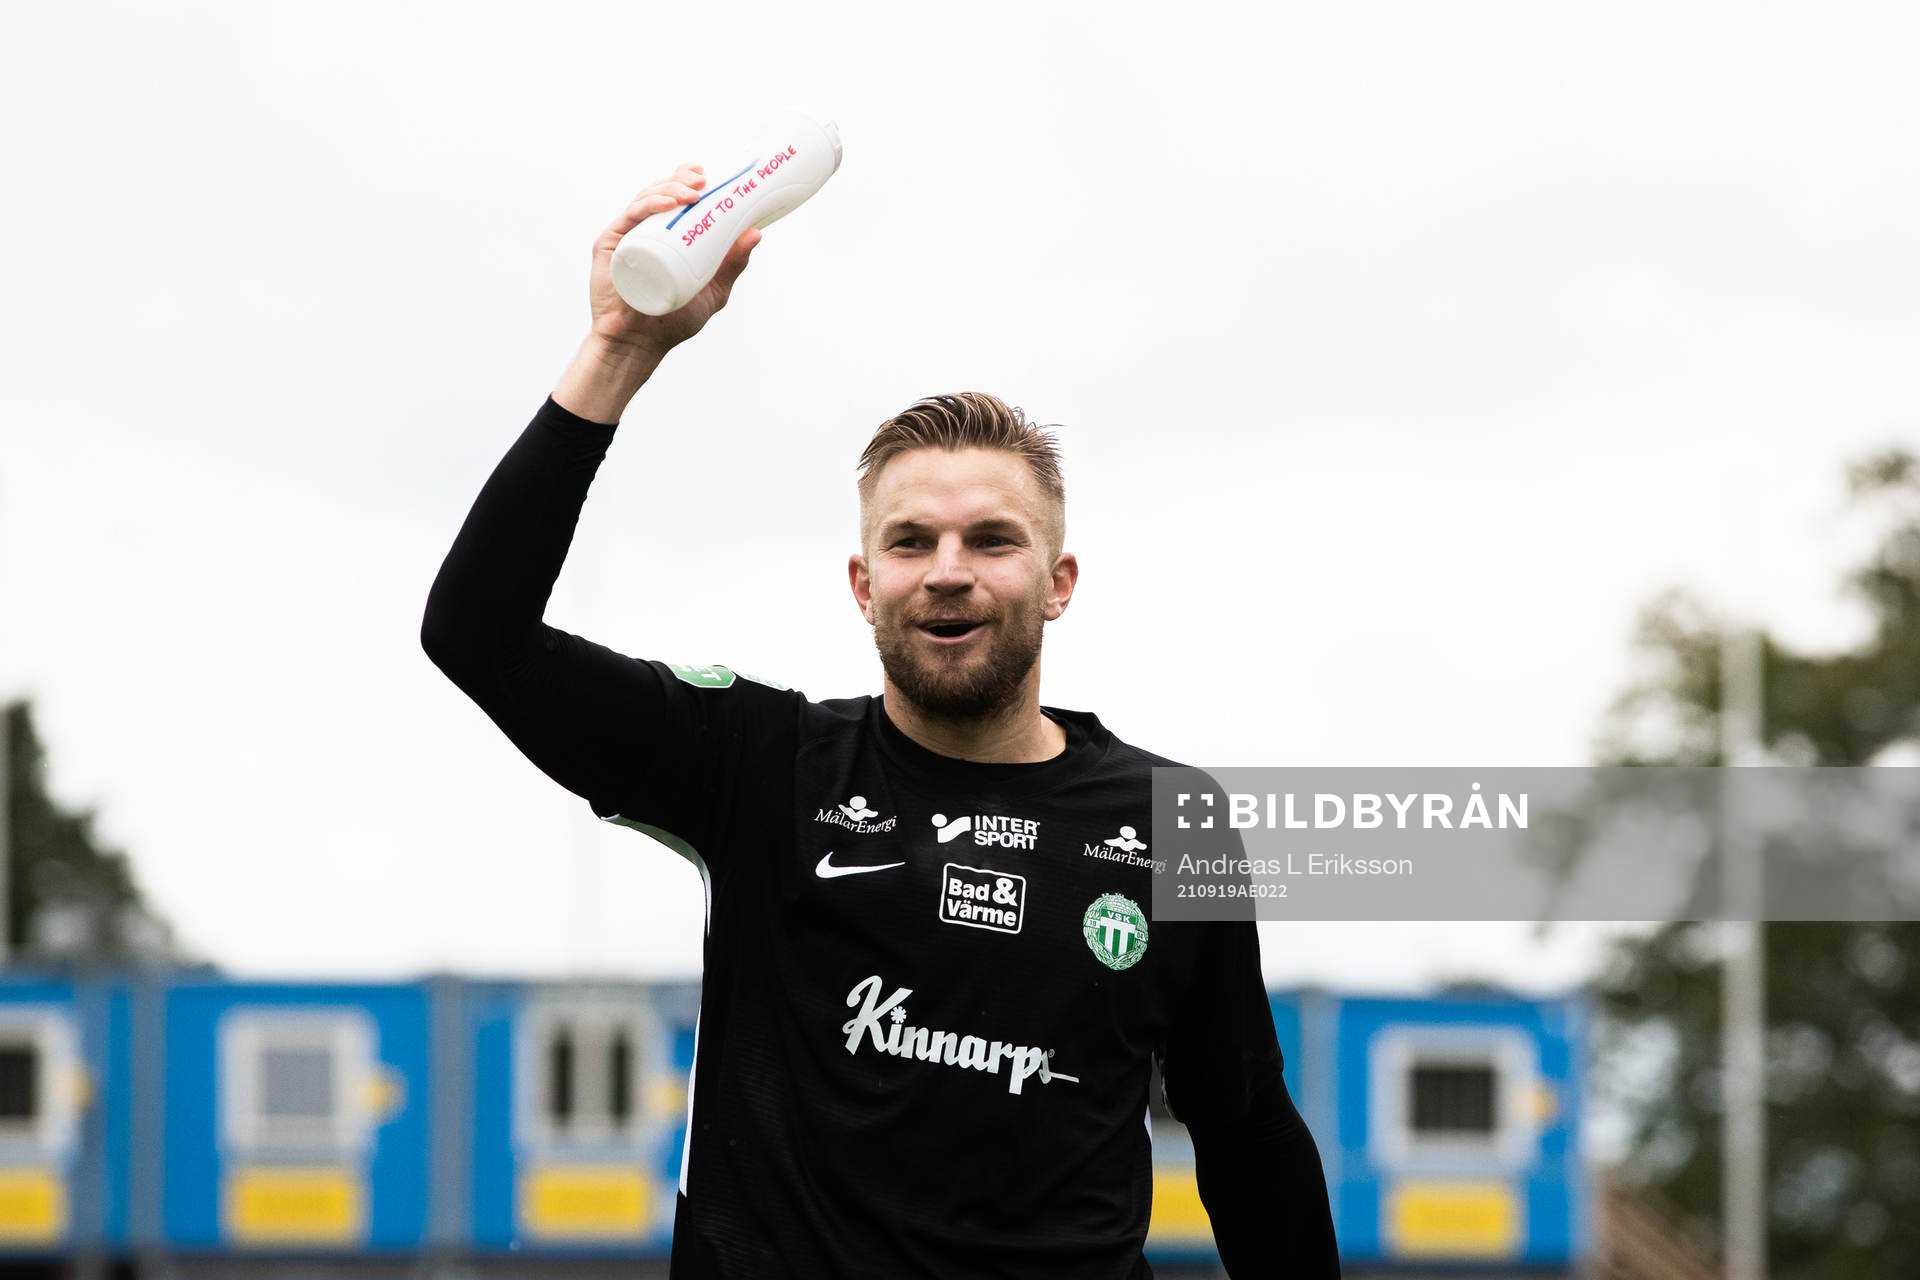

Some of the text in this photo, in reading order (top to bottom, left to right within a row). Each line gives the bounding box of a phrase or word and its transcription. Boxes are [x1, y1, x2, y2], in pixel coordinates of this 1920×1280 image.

[681, 145, 797, 246] SPORT TO THE PEOPLE
[814, 808, 898, 834] MälarEnergi
[974, 815, 1037, 836] INTER
[974, 831, 1038, 850] SPORT
[1083, 843, 1168, 875] MälarEnergi
[948, 878, 1018, 907] Bad &
[947, 899, 1017, 927] Värme
[1107, 911, 1131, 924] VSK
[842, 975, 1080, 1096] Kinnarps
